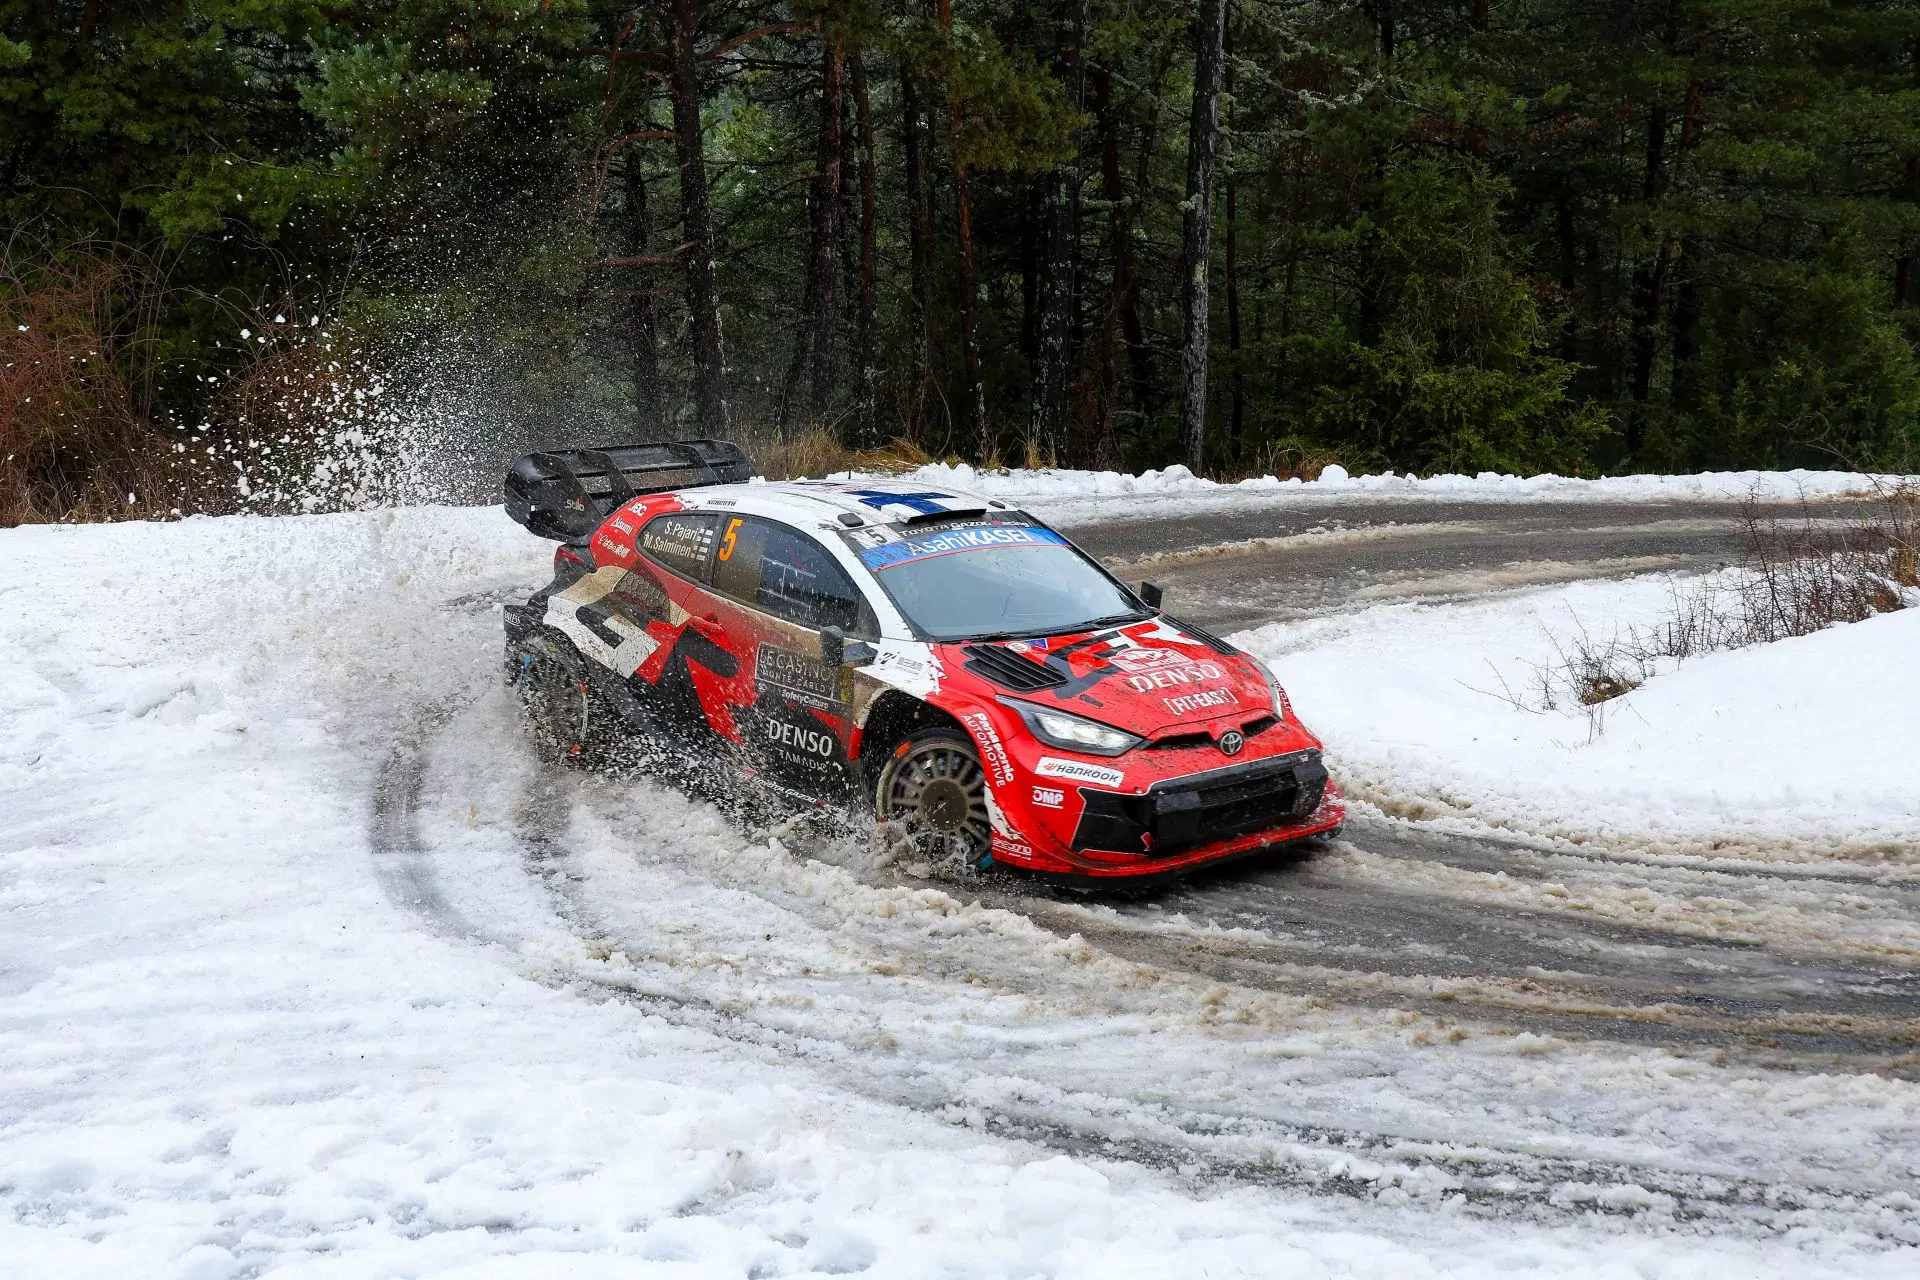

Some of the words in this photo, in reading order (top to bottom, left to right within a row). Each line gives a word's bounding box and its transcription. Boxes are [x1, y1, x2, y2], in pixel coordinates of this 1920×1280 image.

[664, 521, 699, 541] S.Pajari
[719, 518, 743, 561] 5
[869, 527, 888, 544] 5
[901, 524, 950, 537] TOYOTA
[951, 521, 991, 531] GAZOO
[642, 533, 692, 558] M.Salminen
[1127, 664, 1221, 693] DENSO
[768, 718, 833, 757] DENSO
[973, 712, 1015, 783] Panasonic
[961, 714, 1006, 789] AUTOMOTIVE
[1031, 789, 1064, 805] OMP
